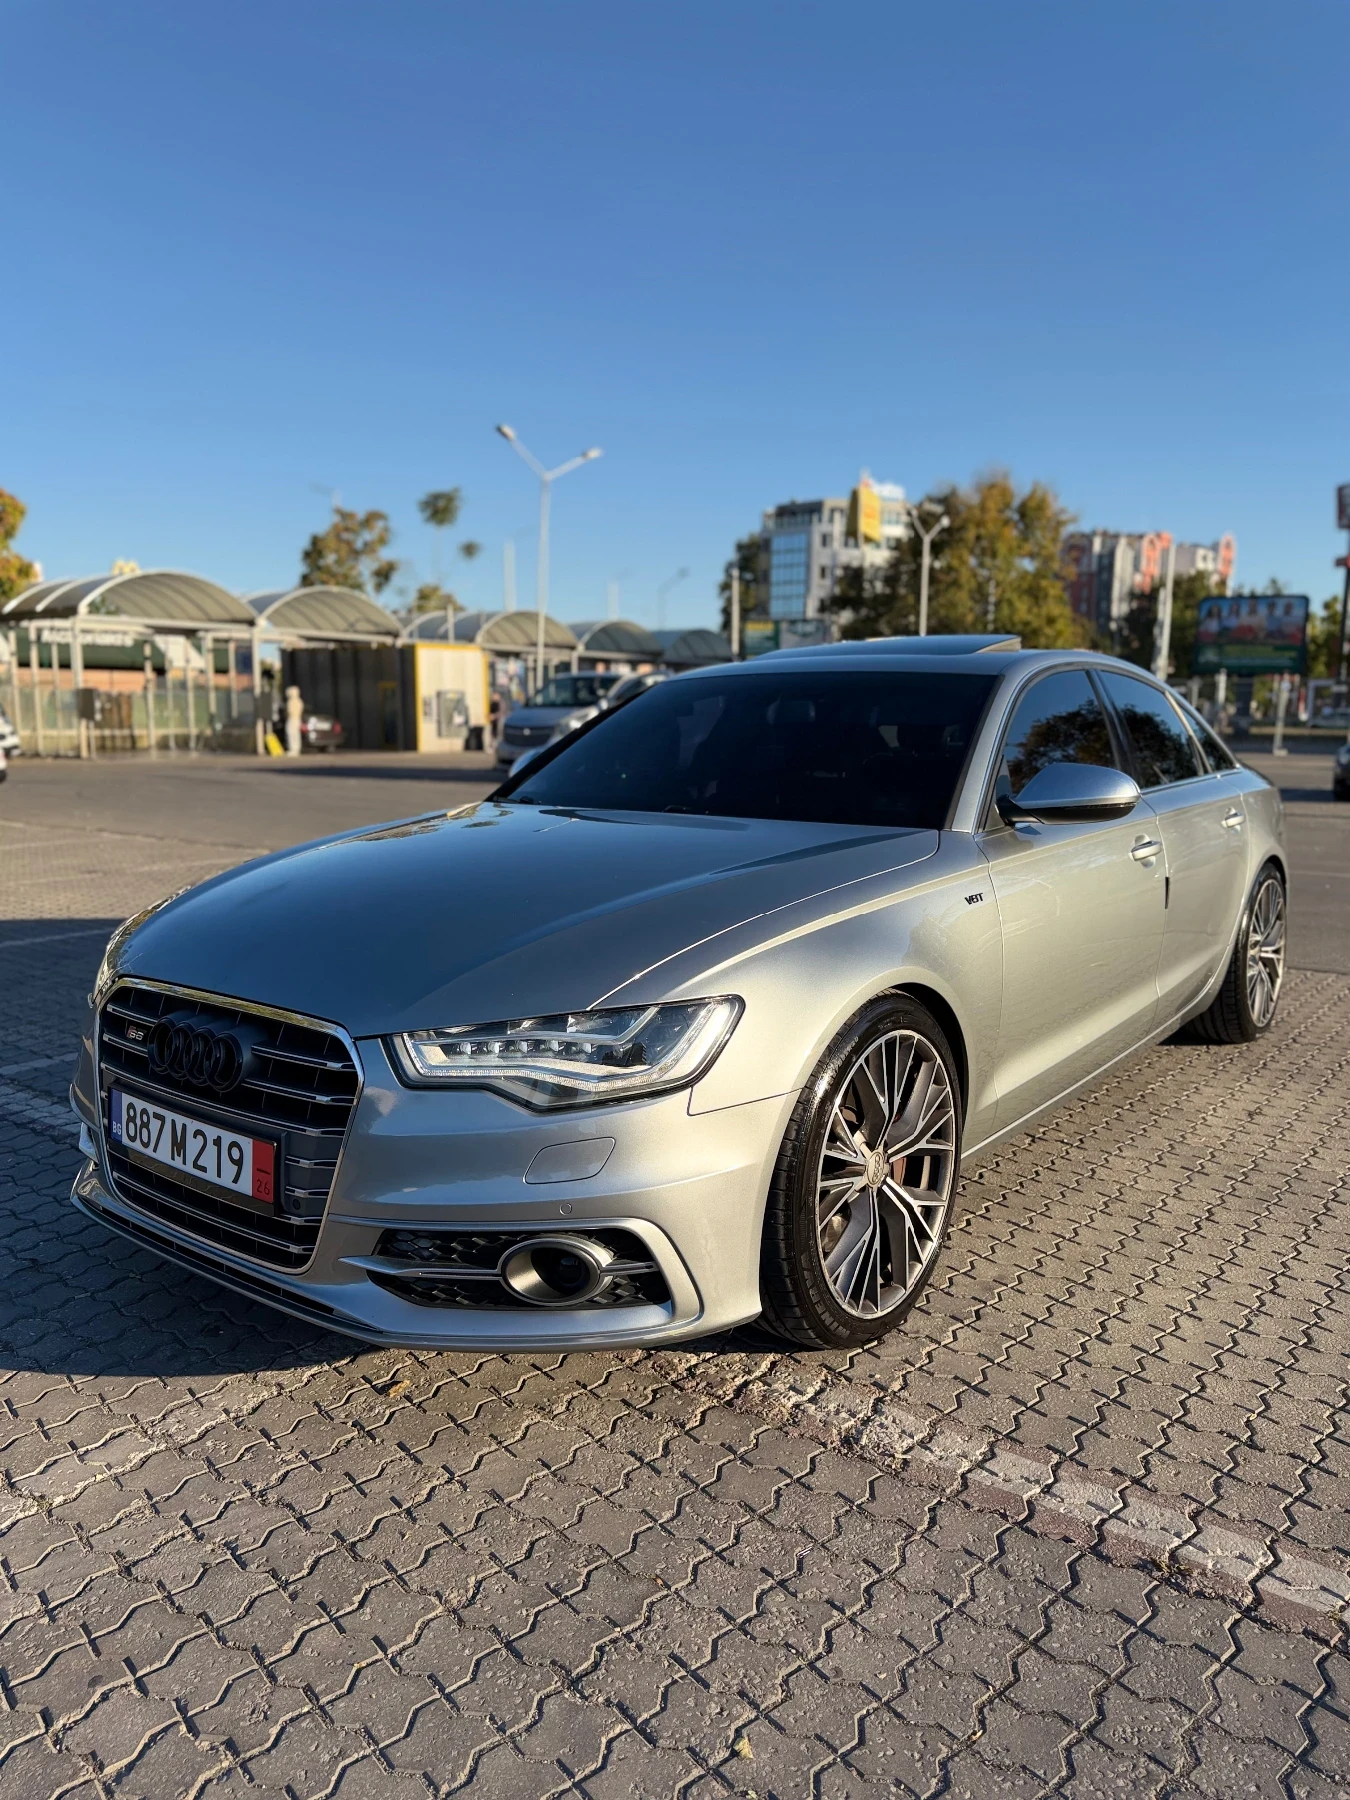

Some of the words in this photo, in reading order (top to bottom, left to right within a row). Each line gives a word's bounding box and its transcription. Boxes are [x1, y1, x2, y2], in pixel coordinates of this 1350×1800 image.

[964, 892, 984, 905] V8T
[112, 1121, 122, 1136] BG
[256, 1178, 270, 1196] 26
[801, 1252, 851, 1339] MINERVA
